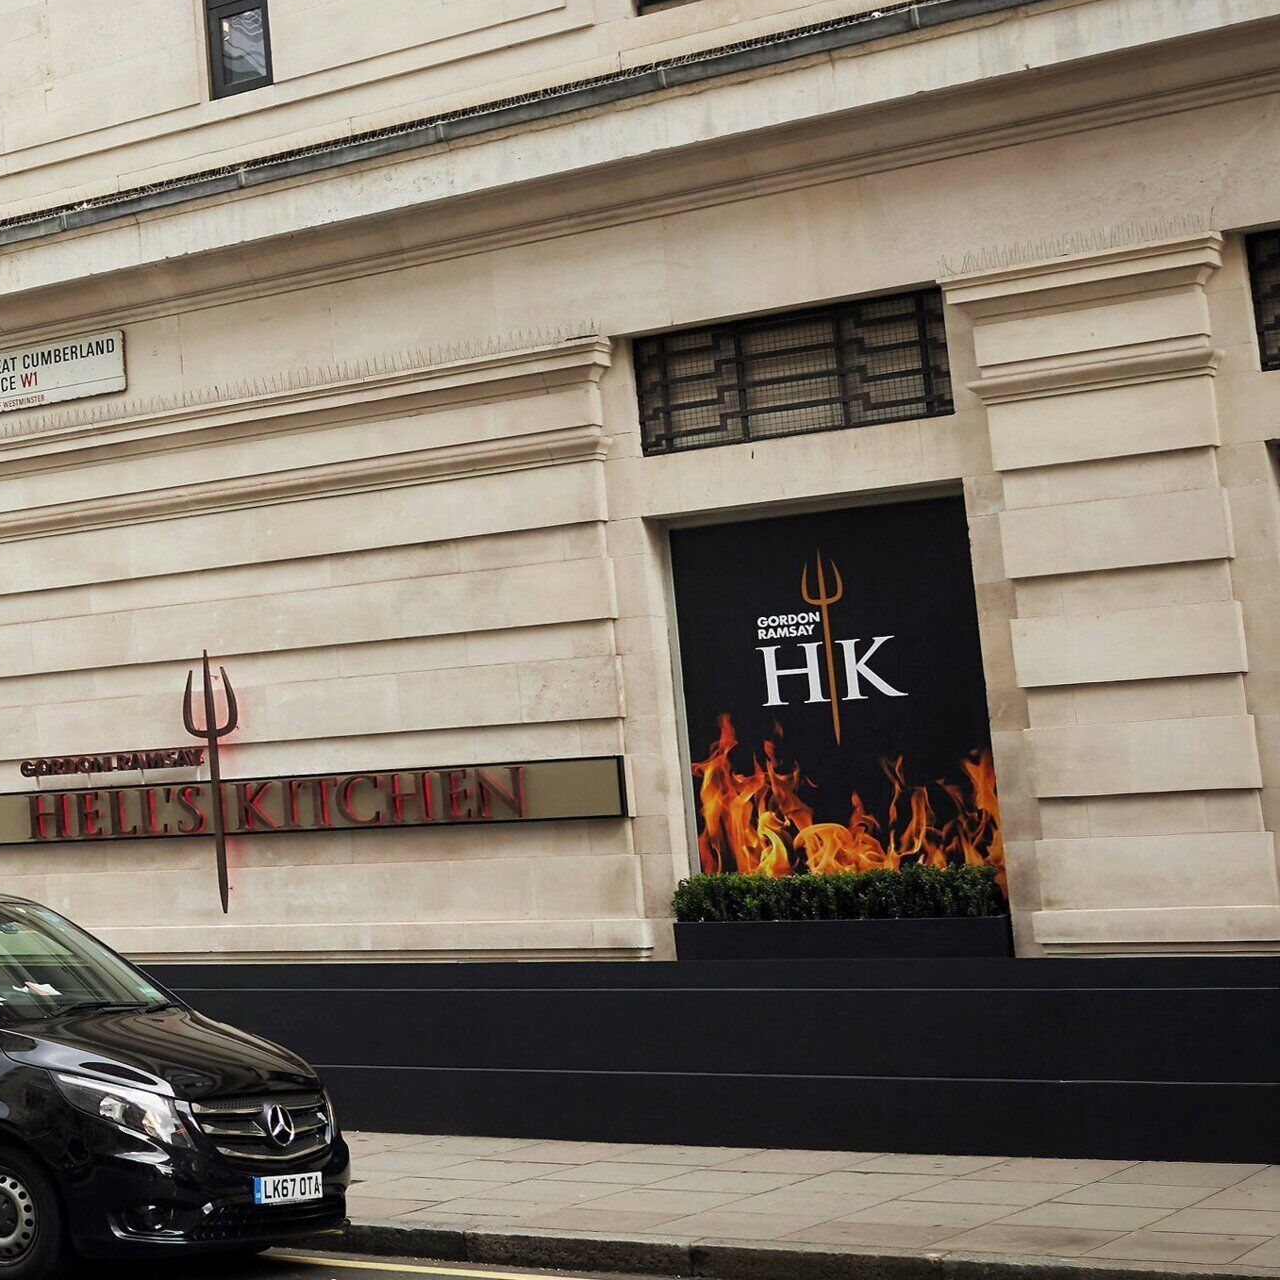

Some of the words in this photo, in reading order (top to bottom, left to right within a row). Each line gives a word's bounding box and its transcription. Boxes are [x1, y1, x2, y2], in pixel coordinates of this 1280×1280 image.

[23, 338, 115, 369] CUMBERLAND
[20, 371, 38, 388] W1
[3, 394, 45, 408] WESTMINSTER
[757, 611, 821, 628] GORDON
[758, 625, 815, 639] RAMSAY
[20, 757, 113, 777] GORDON
[116, 749, 205, 772] RAMSAY
[25, 786, 206, 839] HELL'S
[235, 766, 527, 829] KITCHEN
[264, 1178, 297, 1199] LK67
[300, 1176, 320, 1195] OTA
